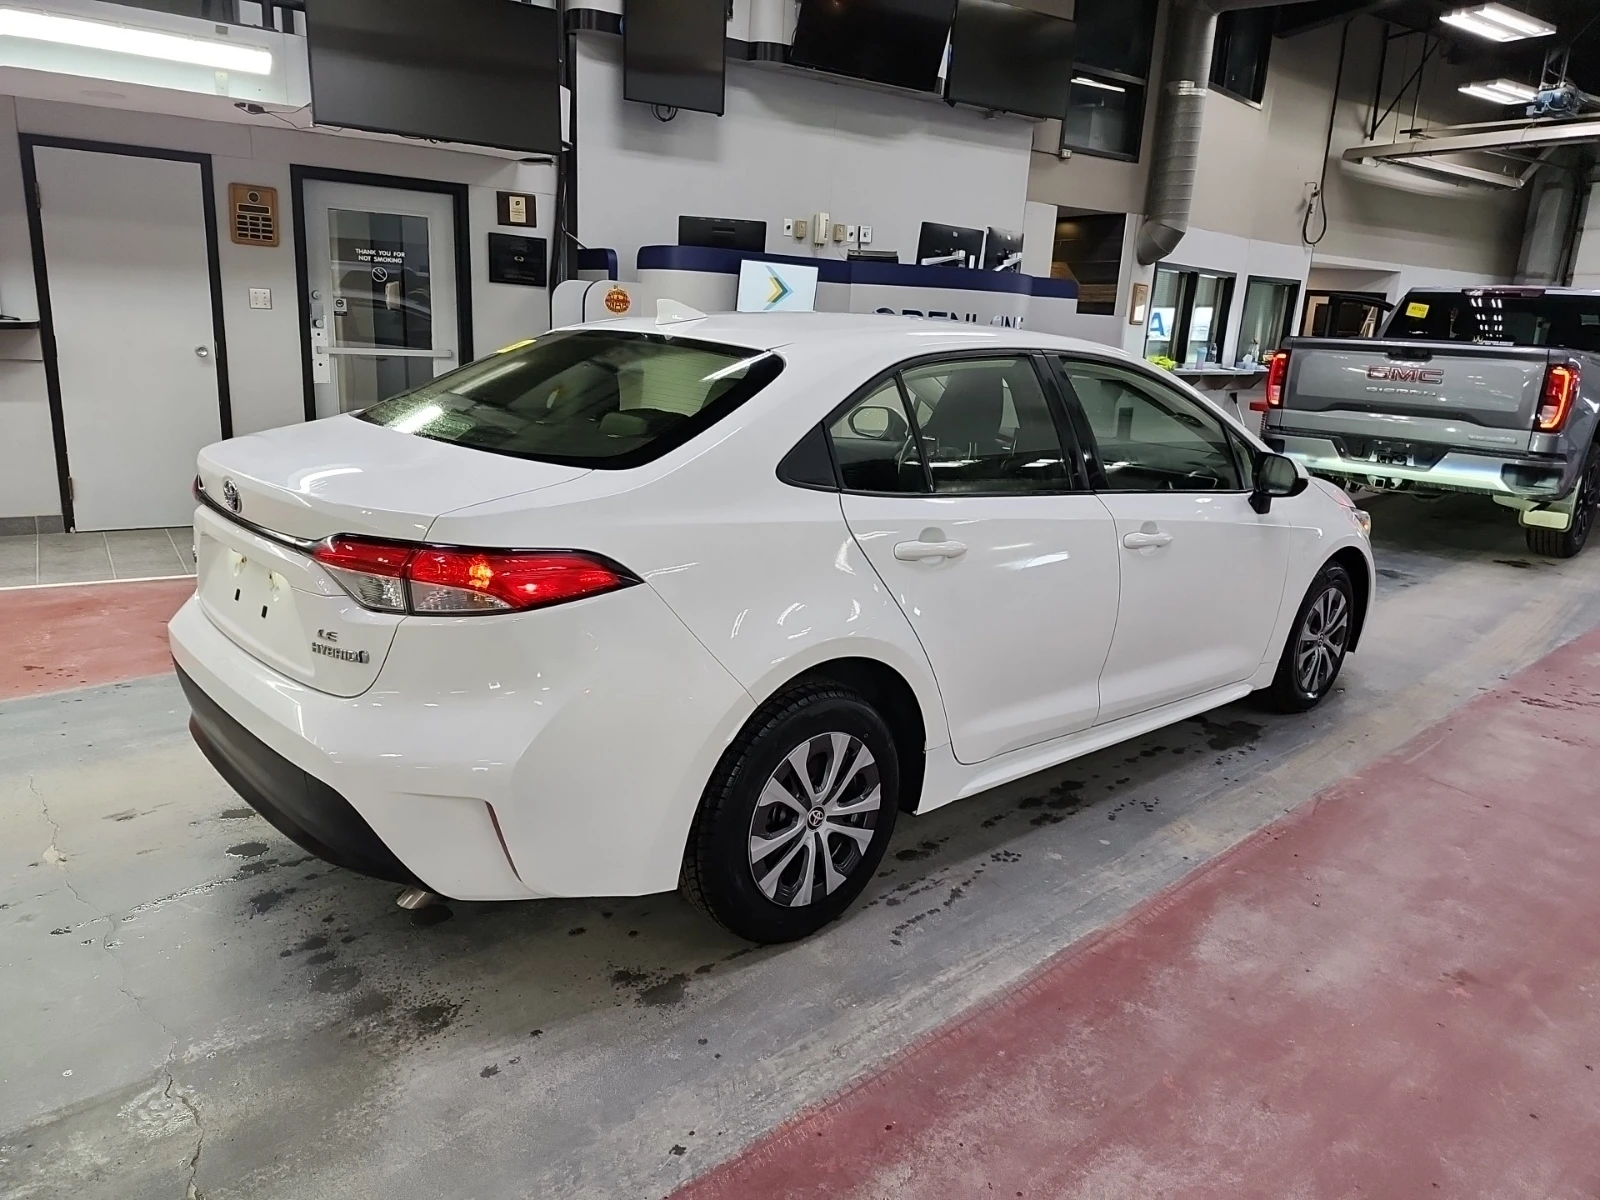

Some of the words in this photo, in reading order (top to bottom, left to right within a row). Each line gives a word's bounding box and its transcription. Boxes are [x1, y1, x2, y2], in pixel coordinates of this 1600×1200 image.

[373, 256, 402, 264] SMOKING
[1366, 365, 1445, 385] GMC
[317, 628, 338, 642] LE
[311, 641, 360, 663] HYBRID
